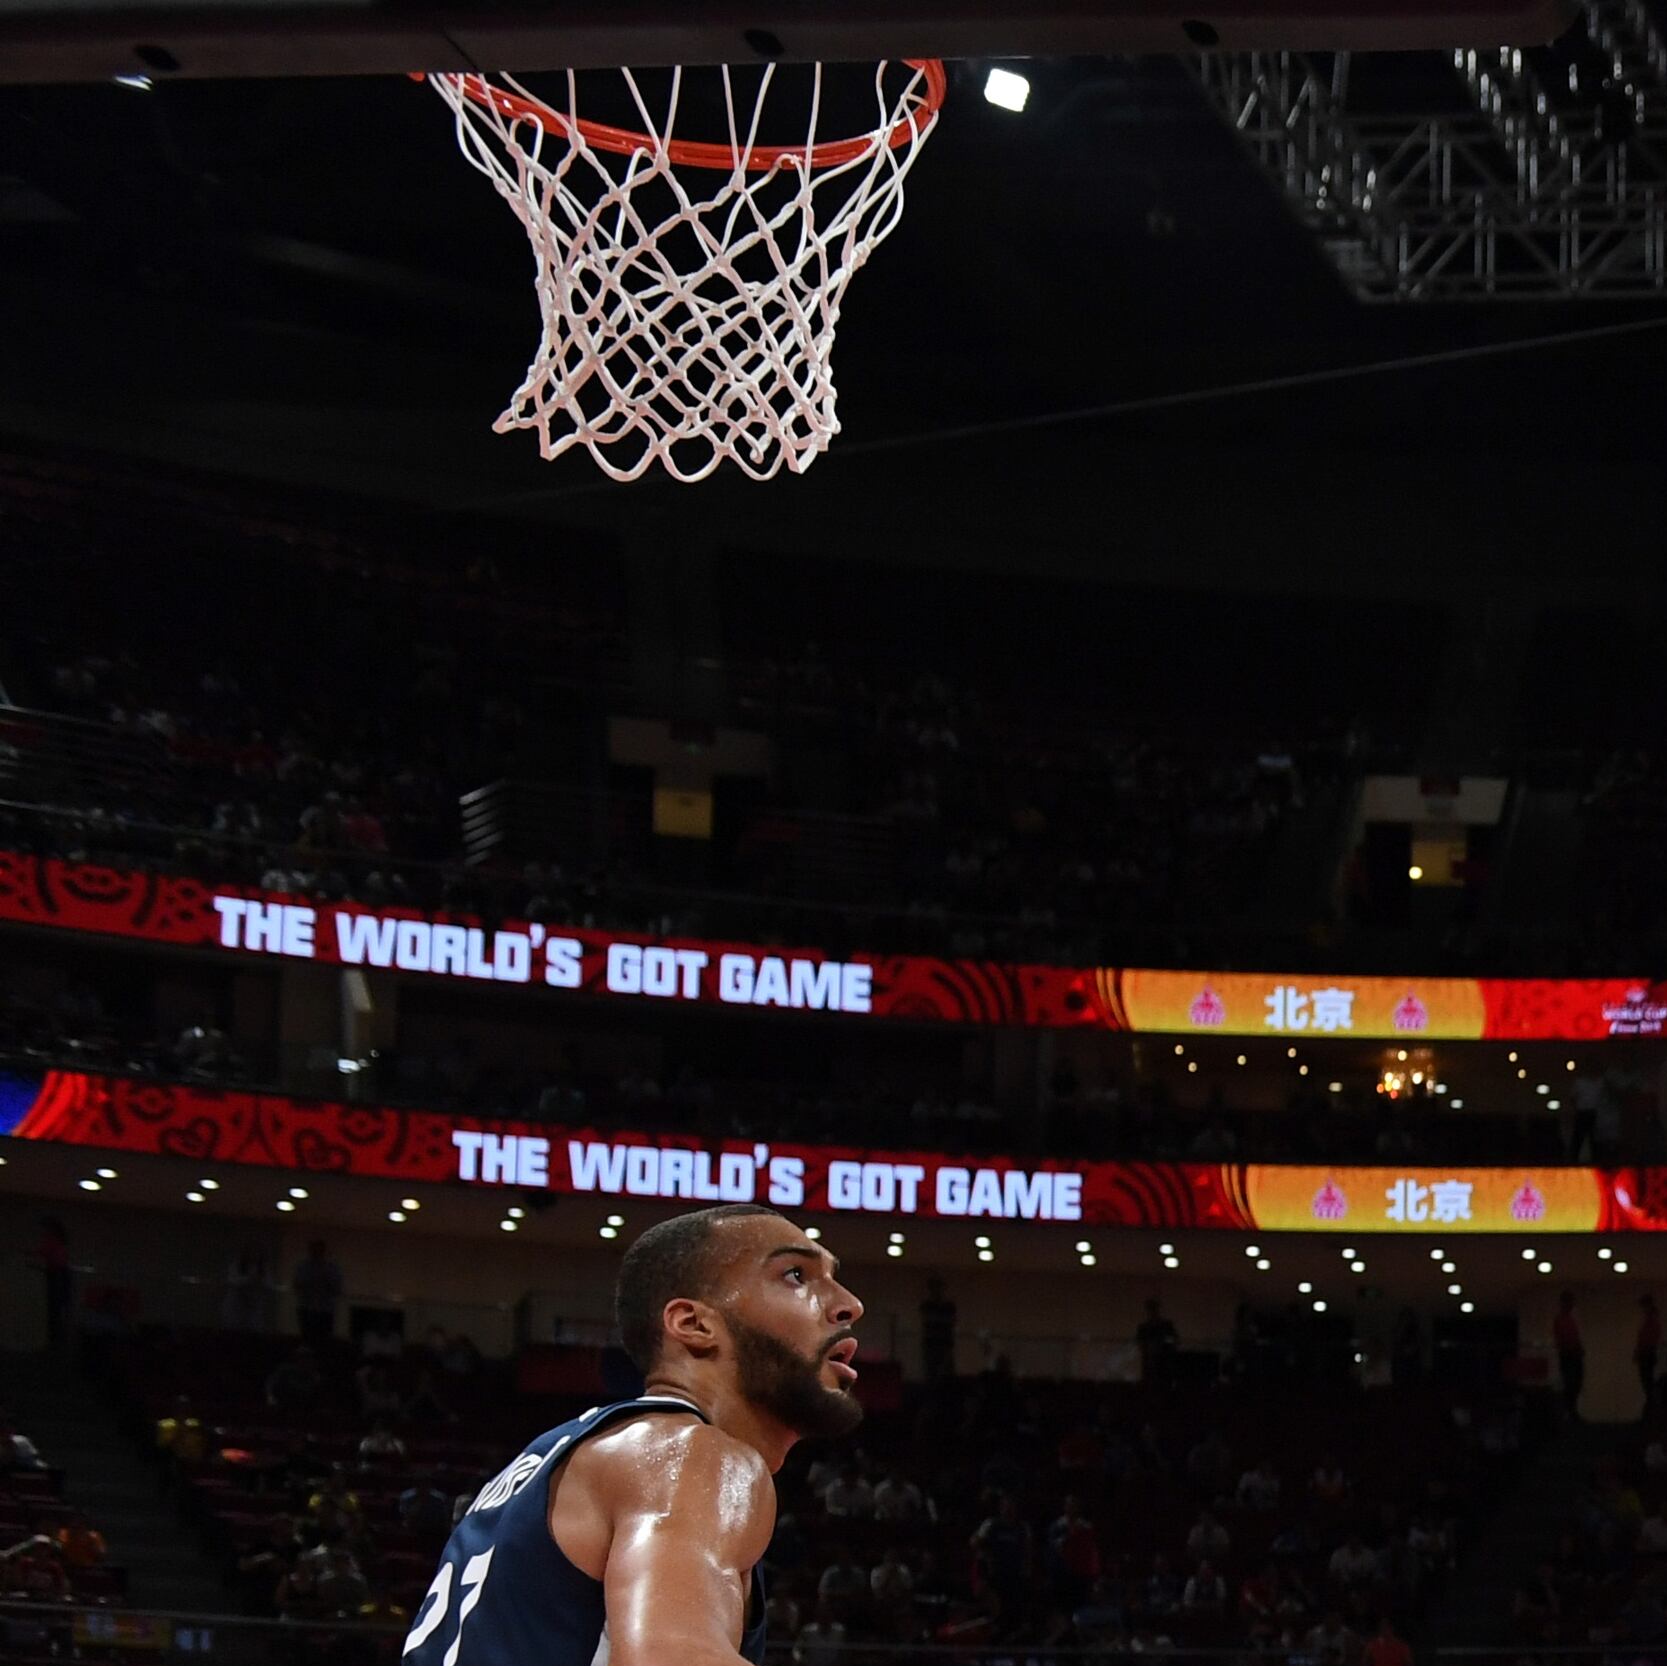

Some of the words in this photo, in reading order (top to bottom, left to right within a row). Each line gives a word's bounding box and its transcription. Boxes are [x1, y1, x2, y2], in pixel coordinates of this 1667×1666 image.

[212, 895, 316, 959] THE
[335, 912, 582, 988] WORLD'S
[606, 943, 707, 999] GOT
[719, 954, 873, 1013] GAME
[1264, 986, 1354, 1032] 北京
[451, 1131, 549, 1187] THE
[568, 1141, 804, 1206] WORLD'S
[827, 1161, 925, 1213] GOT
[935, 1167, 1082, 1221] GAME
[1385, 1178, 1472, 1224] 北京
